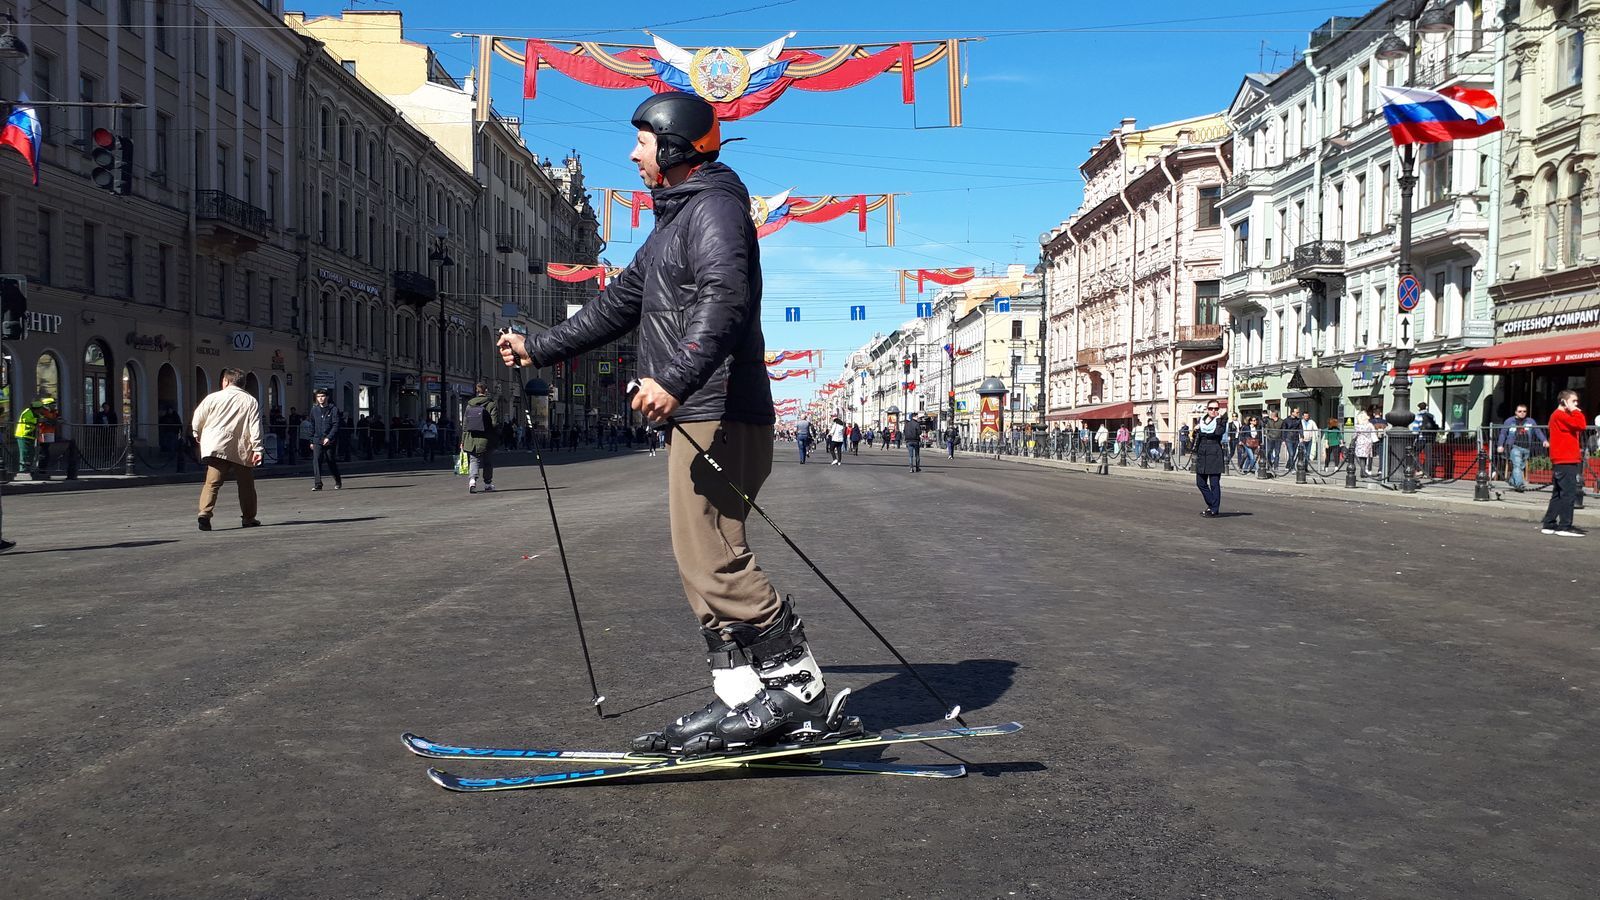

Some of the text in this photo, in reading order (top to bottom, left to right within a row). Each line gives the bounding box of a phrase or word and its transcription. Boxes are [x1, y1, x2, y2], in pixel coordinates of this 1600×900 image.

[1503, 315, 1554, 333] COFFEESHOP
[1554, 308, 1600, 326] COMPANY
[704, 454, 722, 471] LEKI
[430, 744, 560, 757] HEAD
[459, 769, 604, 787] HEAD
